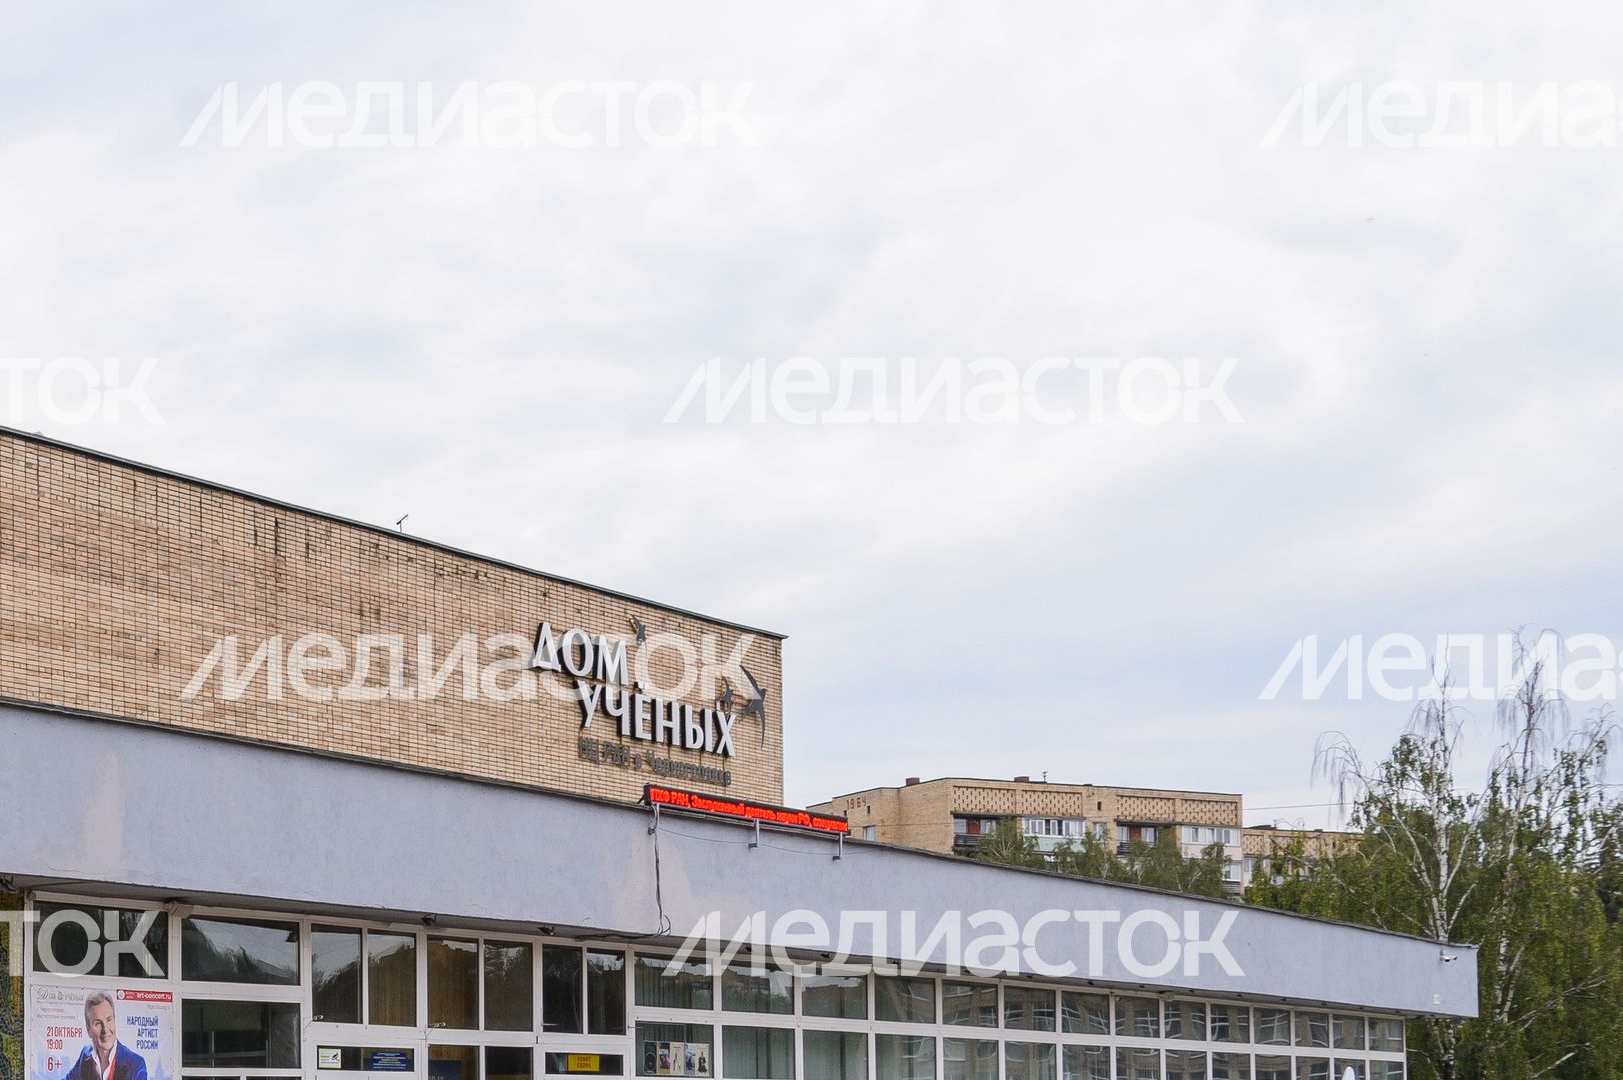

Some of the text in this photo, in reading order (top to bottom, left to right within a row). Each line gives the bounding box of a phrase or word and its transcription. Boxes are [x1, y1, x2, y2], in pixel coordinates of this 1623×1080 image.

[532, 621, 629, 686] ДОМ
[576, 681, 736, 757] УЧЁНЫХ
[603, 741, 630, 768] РАН
[846, 796, 867, 810] 1964
[127, 1015, 159, 1027] НАРОДНЫЙ
[137, 1028, 159, 1038] АРТИСТ
[46, 1039, 63, 1050] 19:00
[137, 1039, 159, 1050] РОССИИ
[47, 1056, 62, 1072] 6+
